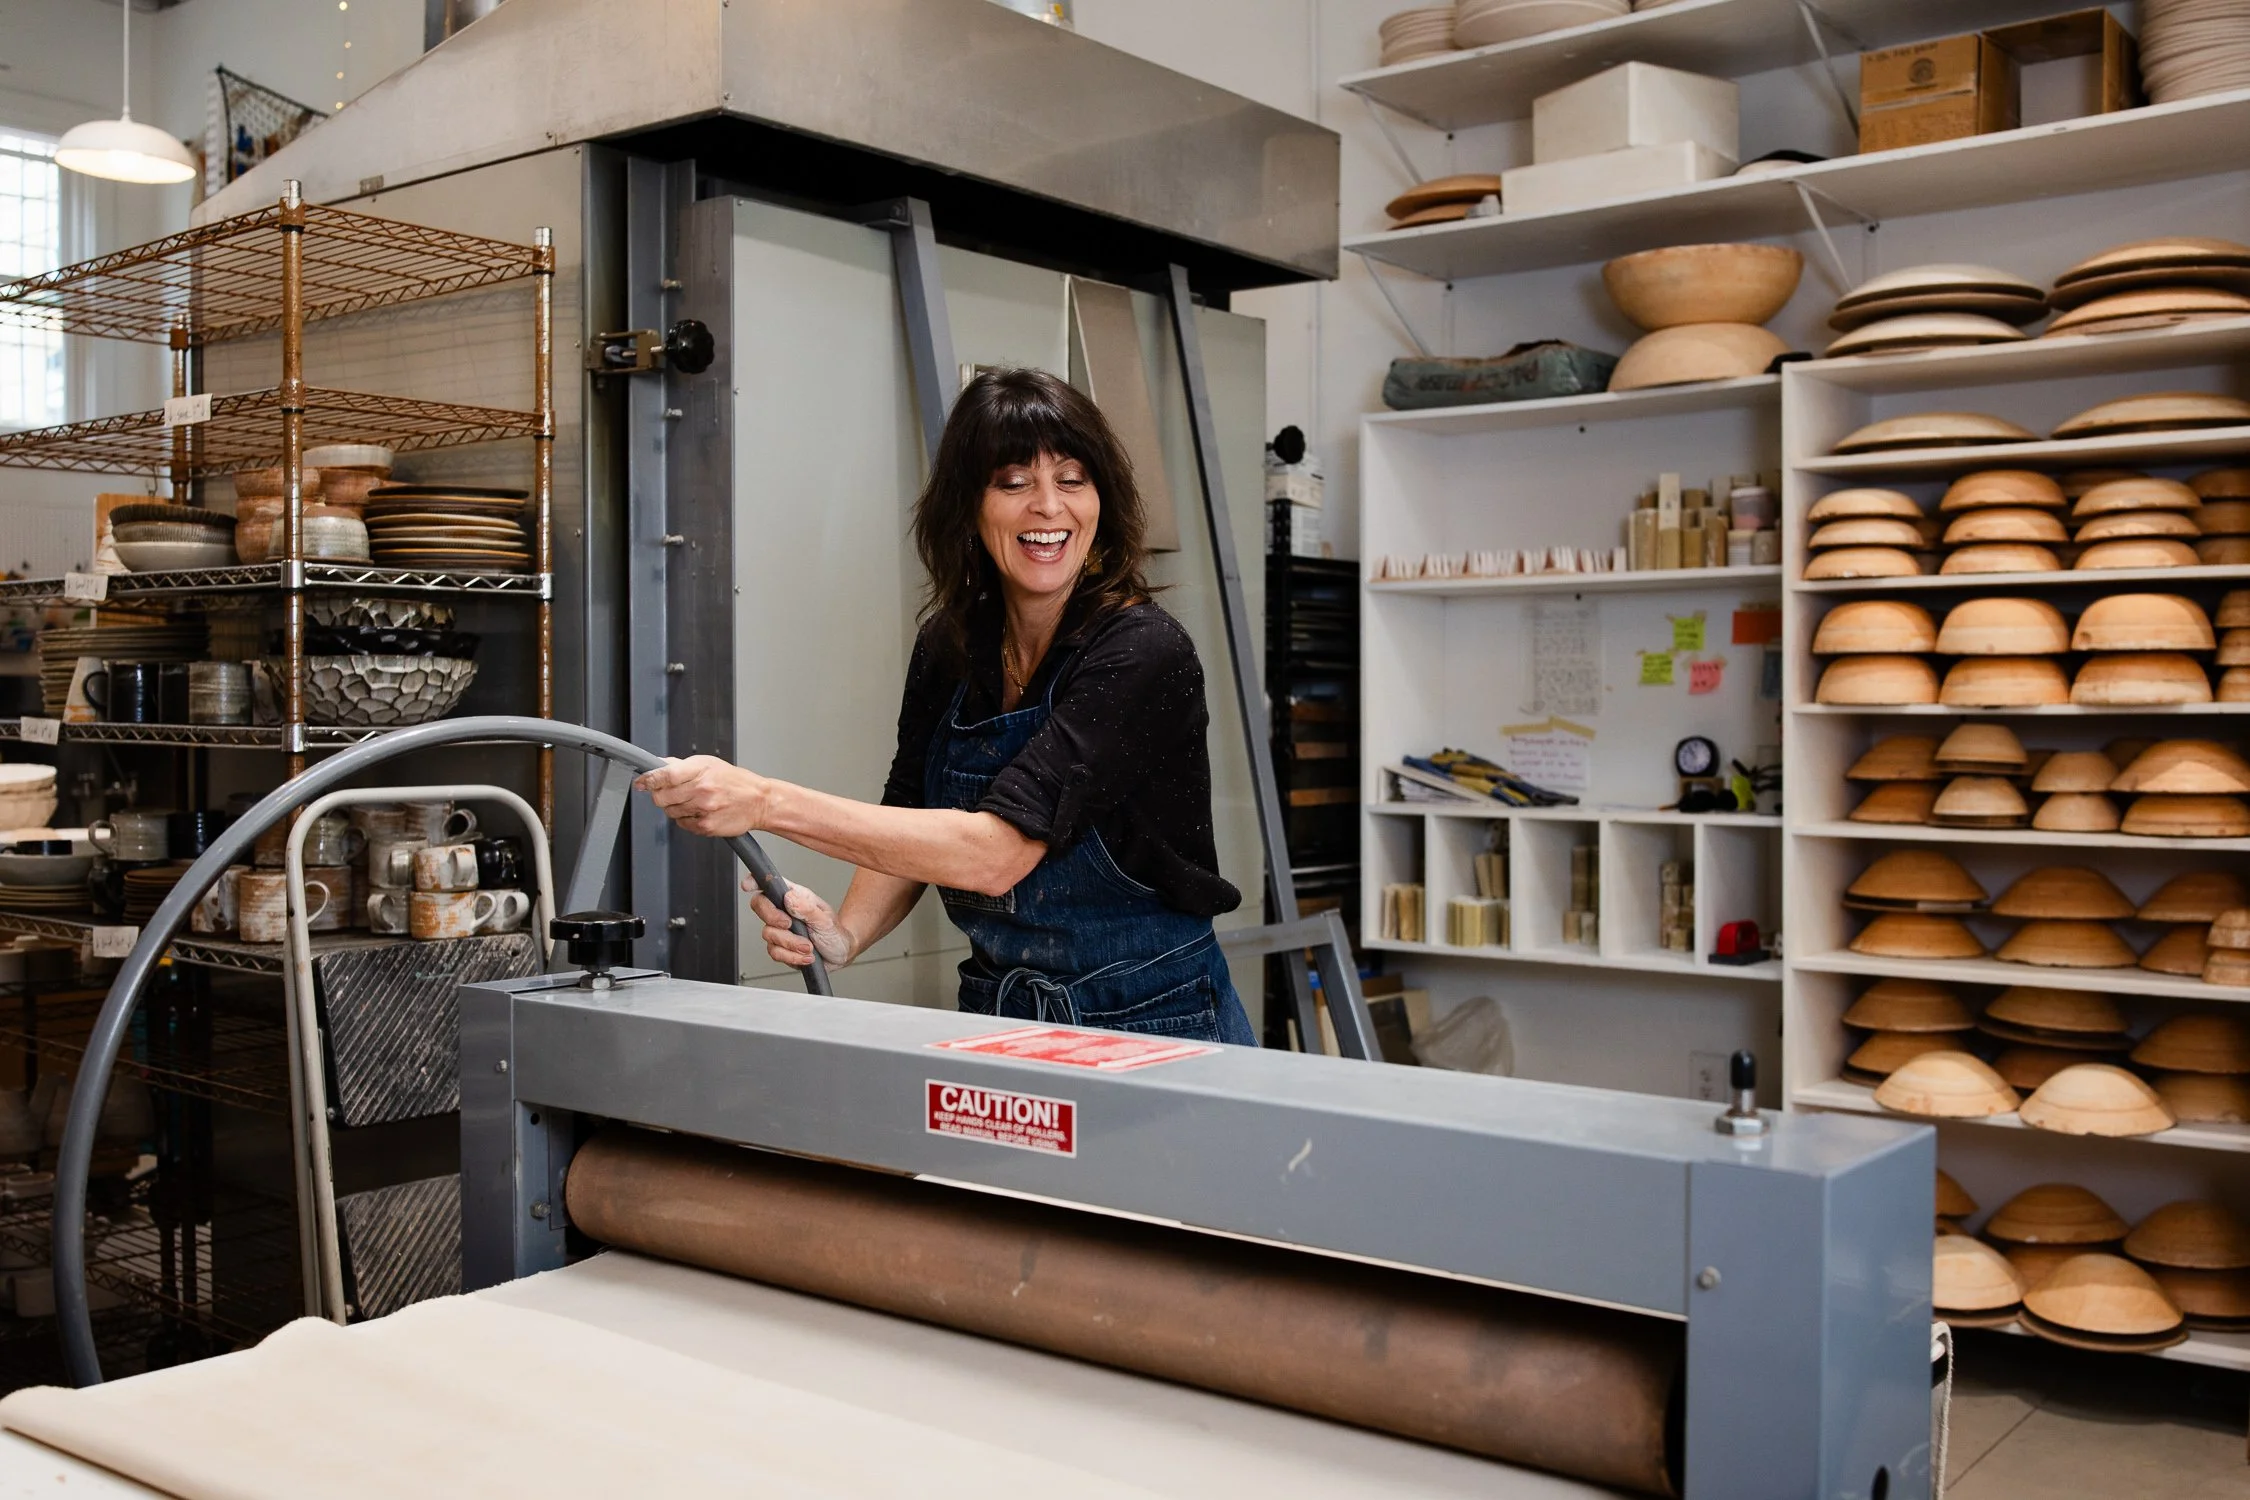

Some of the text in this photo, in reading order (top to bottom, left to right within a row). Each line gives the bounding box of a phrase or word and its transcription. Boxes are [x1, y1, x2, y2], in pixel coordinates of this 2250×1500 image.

[940, 1086, 1059, 1129] CAUTION!
[933, 1110, 955, 1123] KEEP
[956, 1114, 984, 1128] HANDS
[985, 1118, 1012, 1132] CLEAR
[1013, 1123, 1025, 1135] OF
[940, 1121, 962, 1133] READ
